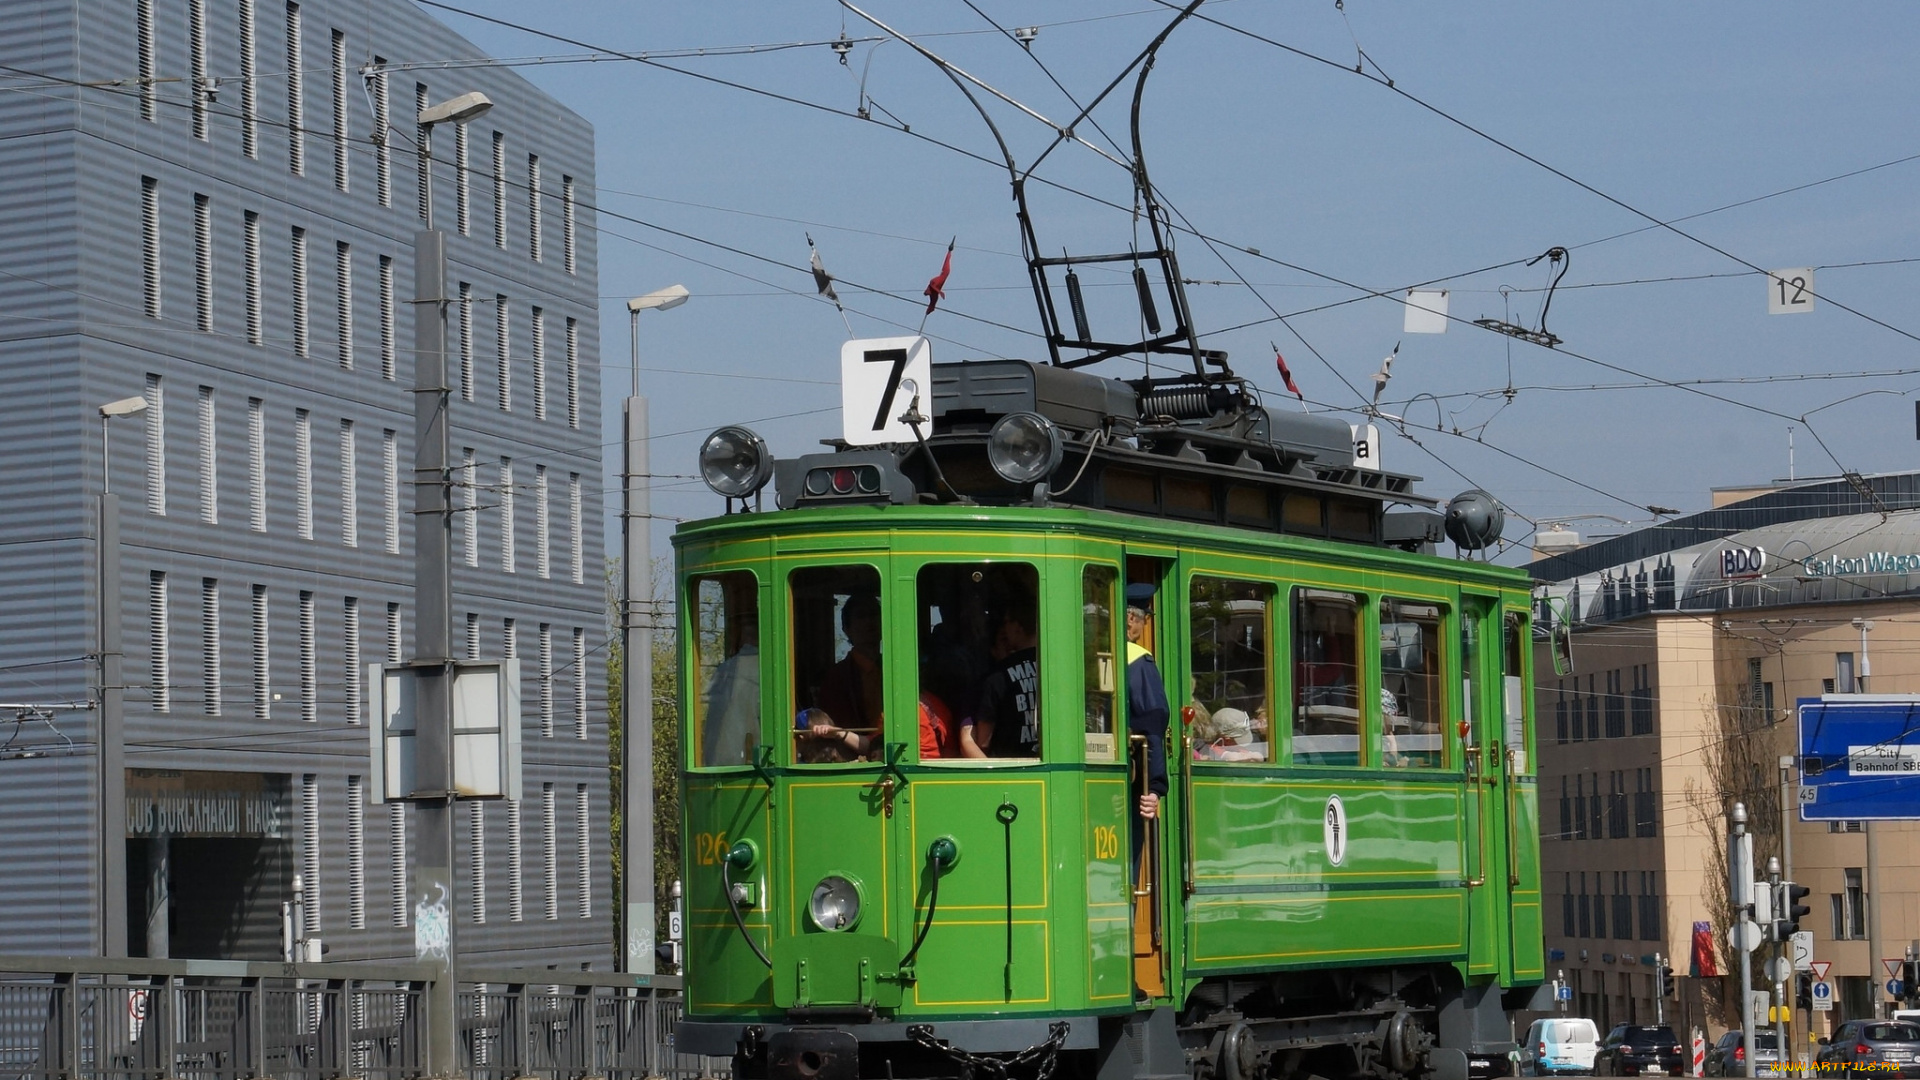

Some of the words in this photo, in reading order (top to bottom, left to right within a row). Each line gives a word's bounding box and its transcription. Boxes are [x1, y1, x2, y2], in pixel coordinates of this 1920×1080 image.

[1777, 276, 1806, 305] 12
[863, 348, 907, 431] 7
[1352, 440, 1369, 459] a
[1724, 546, 1766, 574] BDO
[1804, 554, 1867, 577] Carlson
[1007, 660, 1037, 682] MÄ
[1855, 761, 1899, 772] Bahnhof
[1879, 749, 1900, 761] City
[1800, 788, 1815, 801] 45
[157, 789, 241, 833] BURCKHARDT
[245, 790, 278, 833] HAUS
[694, 831, 731, 866] 126
[1094, 825, 1118, 859] 126
[672, 917, 681, 934] 6
